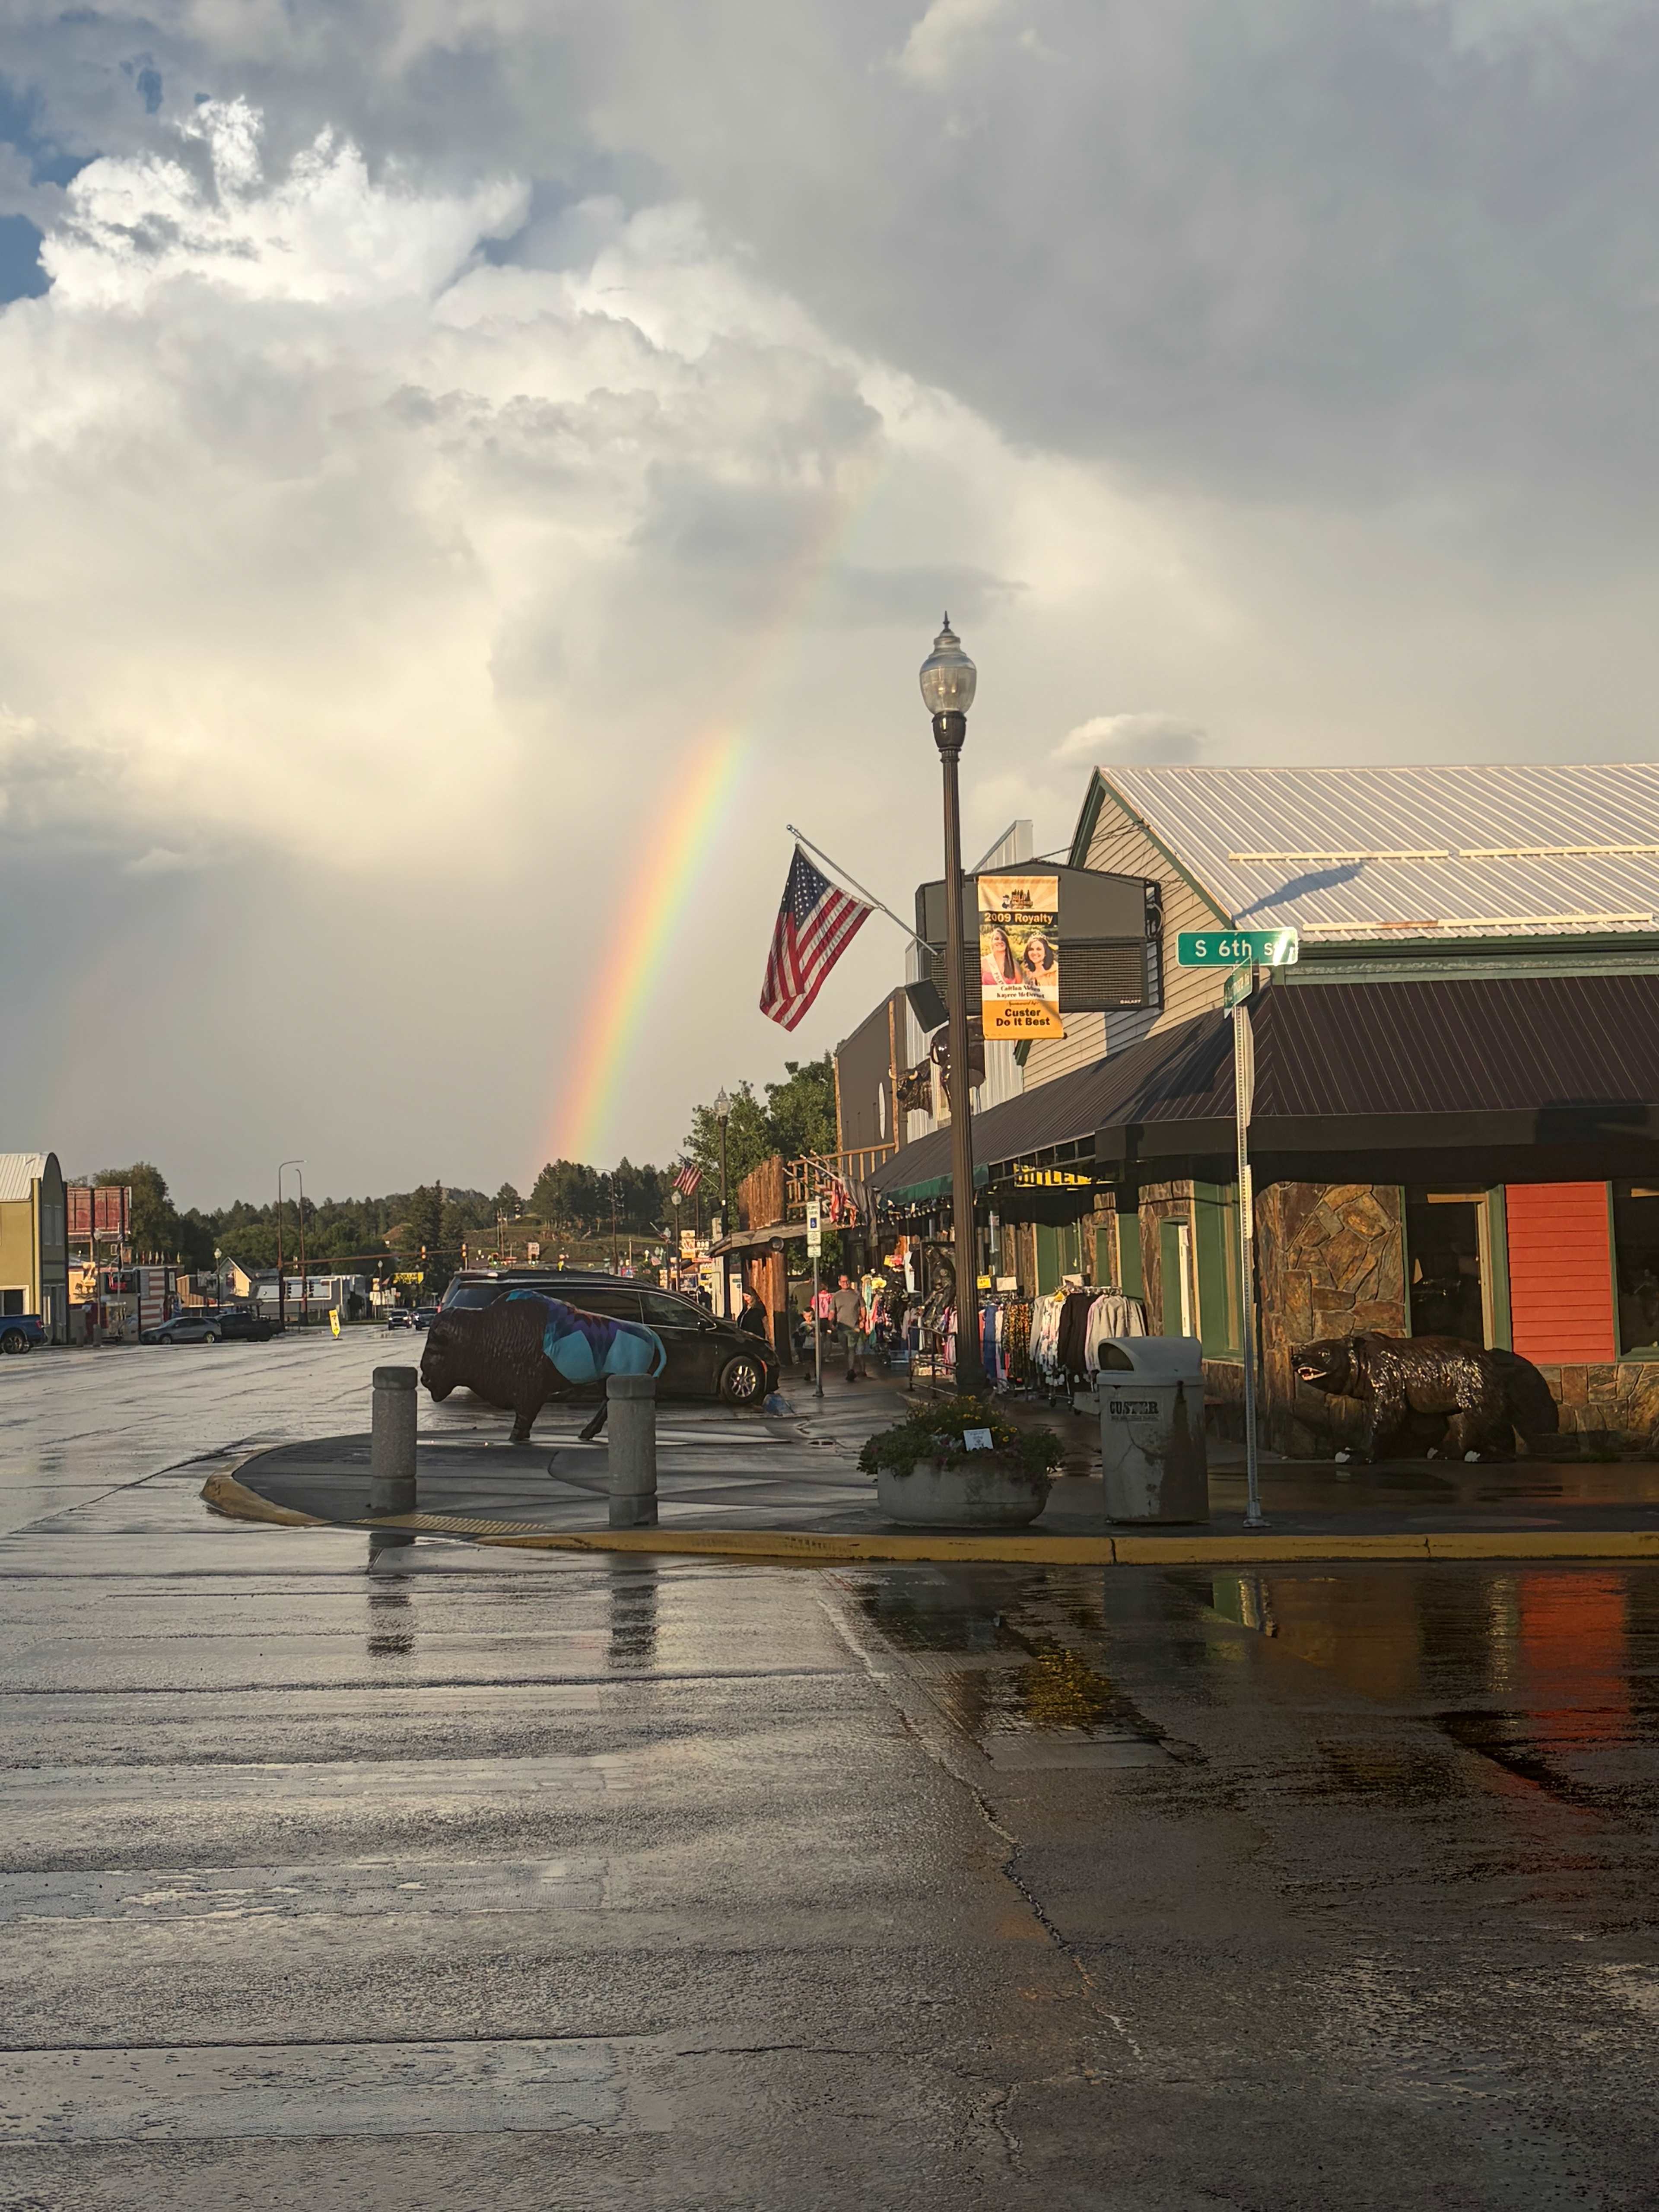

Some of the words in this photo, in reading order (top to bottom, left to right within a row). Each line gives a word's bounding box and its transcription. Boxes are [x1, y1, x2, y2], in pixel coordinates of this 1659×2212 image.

[984, 912, 1011, 922] 2009
[1015, 913, 1053, 925] Royalty
[1195, 940, 1208, 957] S
[1218, 940, 1252, 957] 6th
[1005, 1008, 1041, 1017] Custer
[996, 1018, 1011, 1027] Do
[1014, 1017, 1023, 1026] It
[1025, 1017, 1050, 1026] Best
